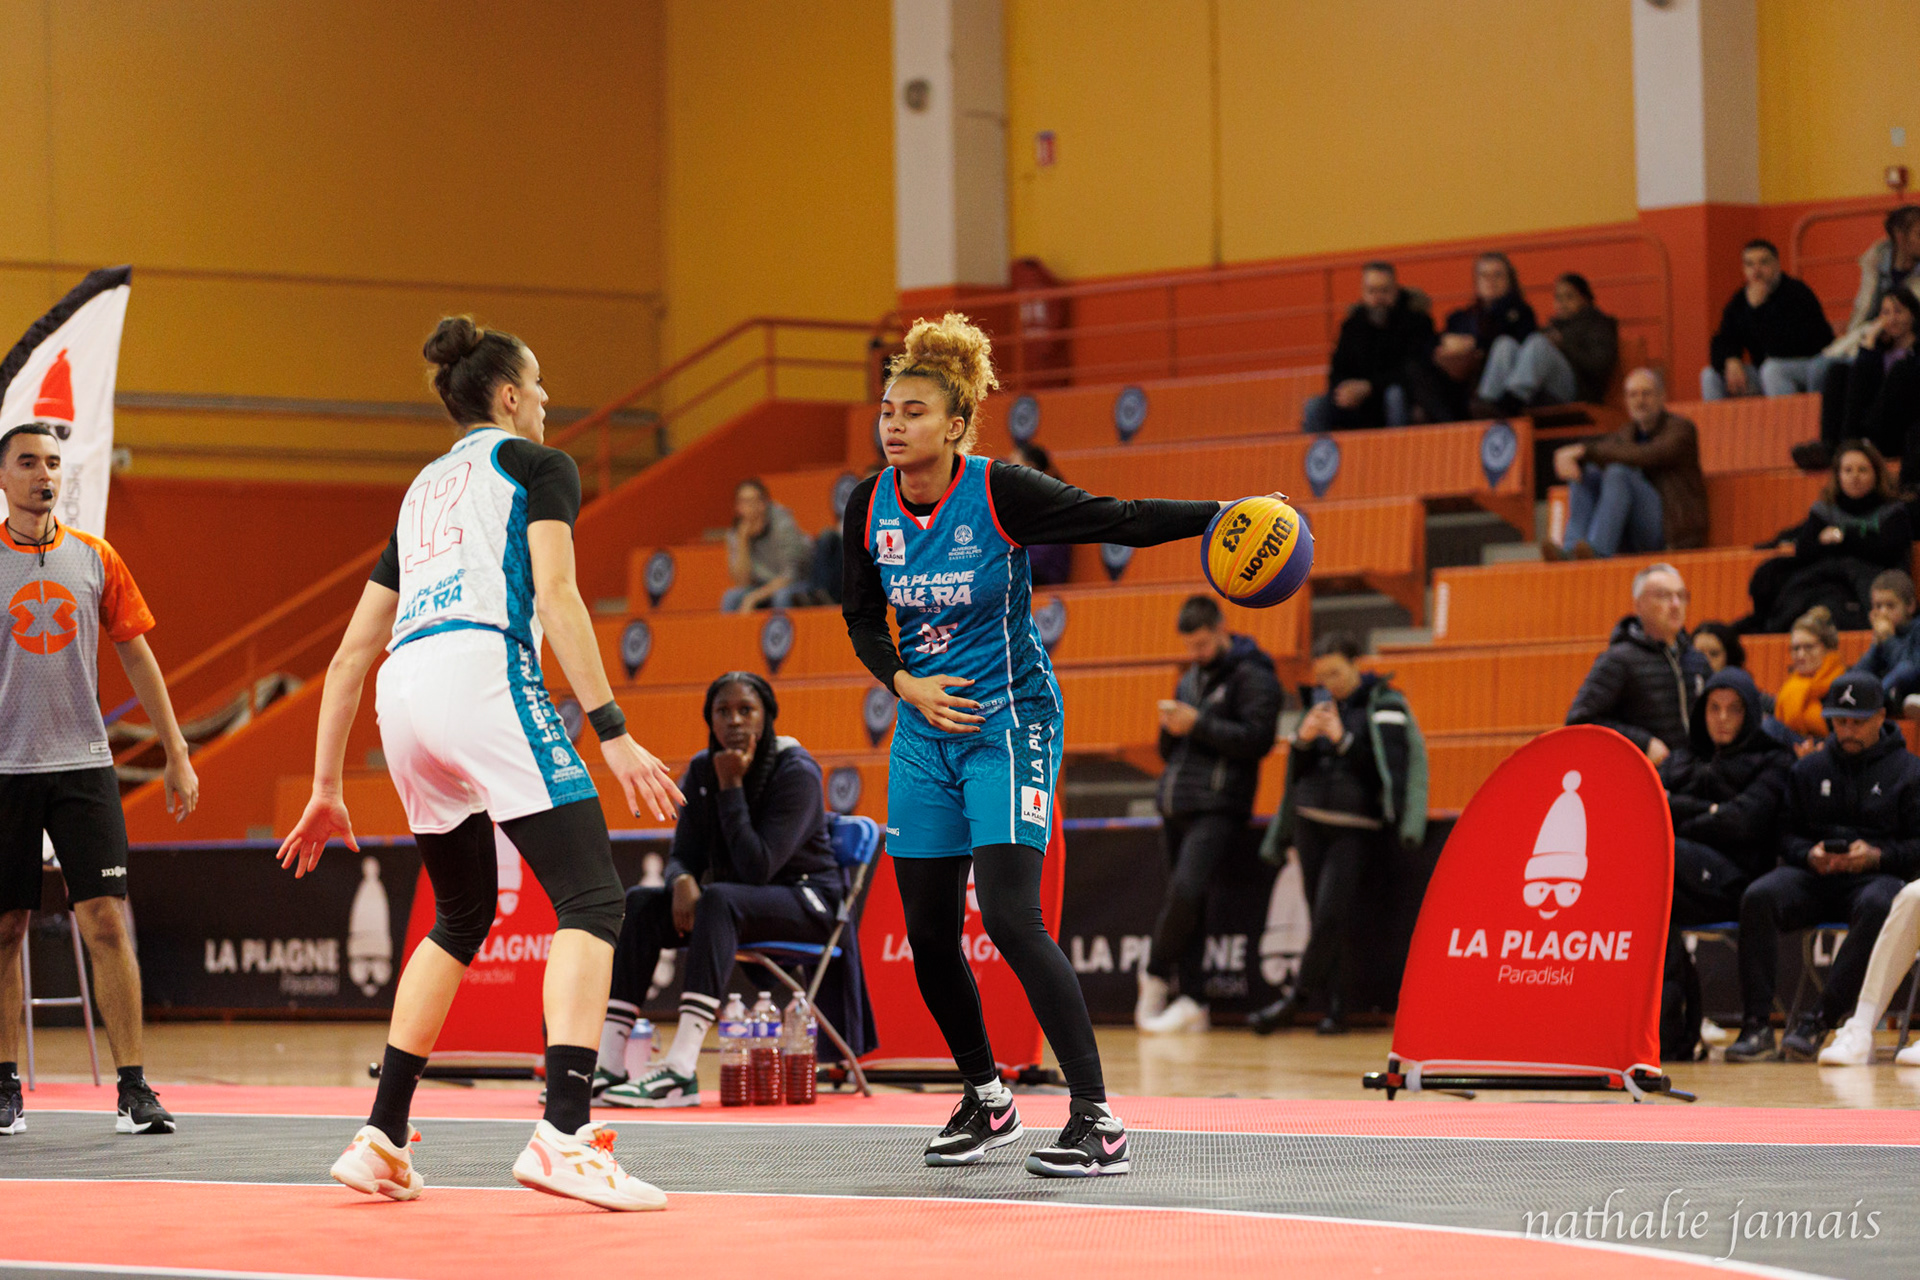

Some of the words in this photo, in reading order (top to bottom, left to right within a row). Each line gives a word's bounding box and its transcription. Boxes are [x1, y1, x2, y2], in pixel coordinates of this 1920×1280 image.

[405, 461, 472, 573] 12
[1239, 516, 1294, 582] Wilson
[889, 574, 908, 587] LA
[909, 570, 975, 587] PLAGNE
[1030, 758, 1045, 784] LA
[204, 937, 238, 973] LA
[241, 937, 340, 973] PLAGNE
[477, 933, 555, 962] LAGNE
[882, 933, 915, 962] LA
[1071, 935, 1114, 973] LA
[1447, 927, 1488, 958] LA
[1500, 929, 1633, 961] PLAGNE
[1497, 964, 1575, 986] Paradiski
